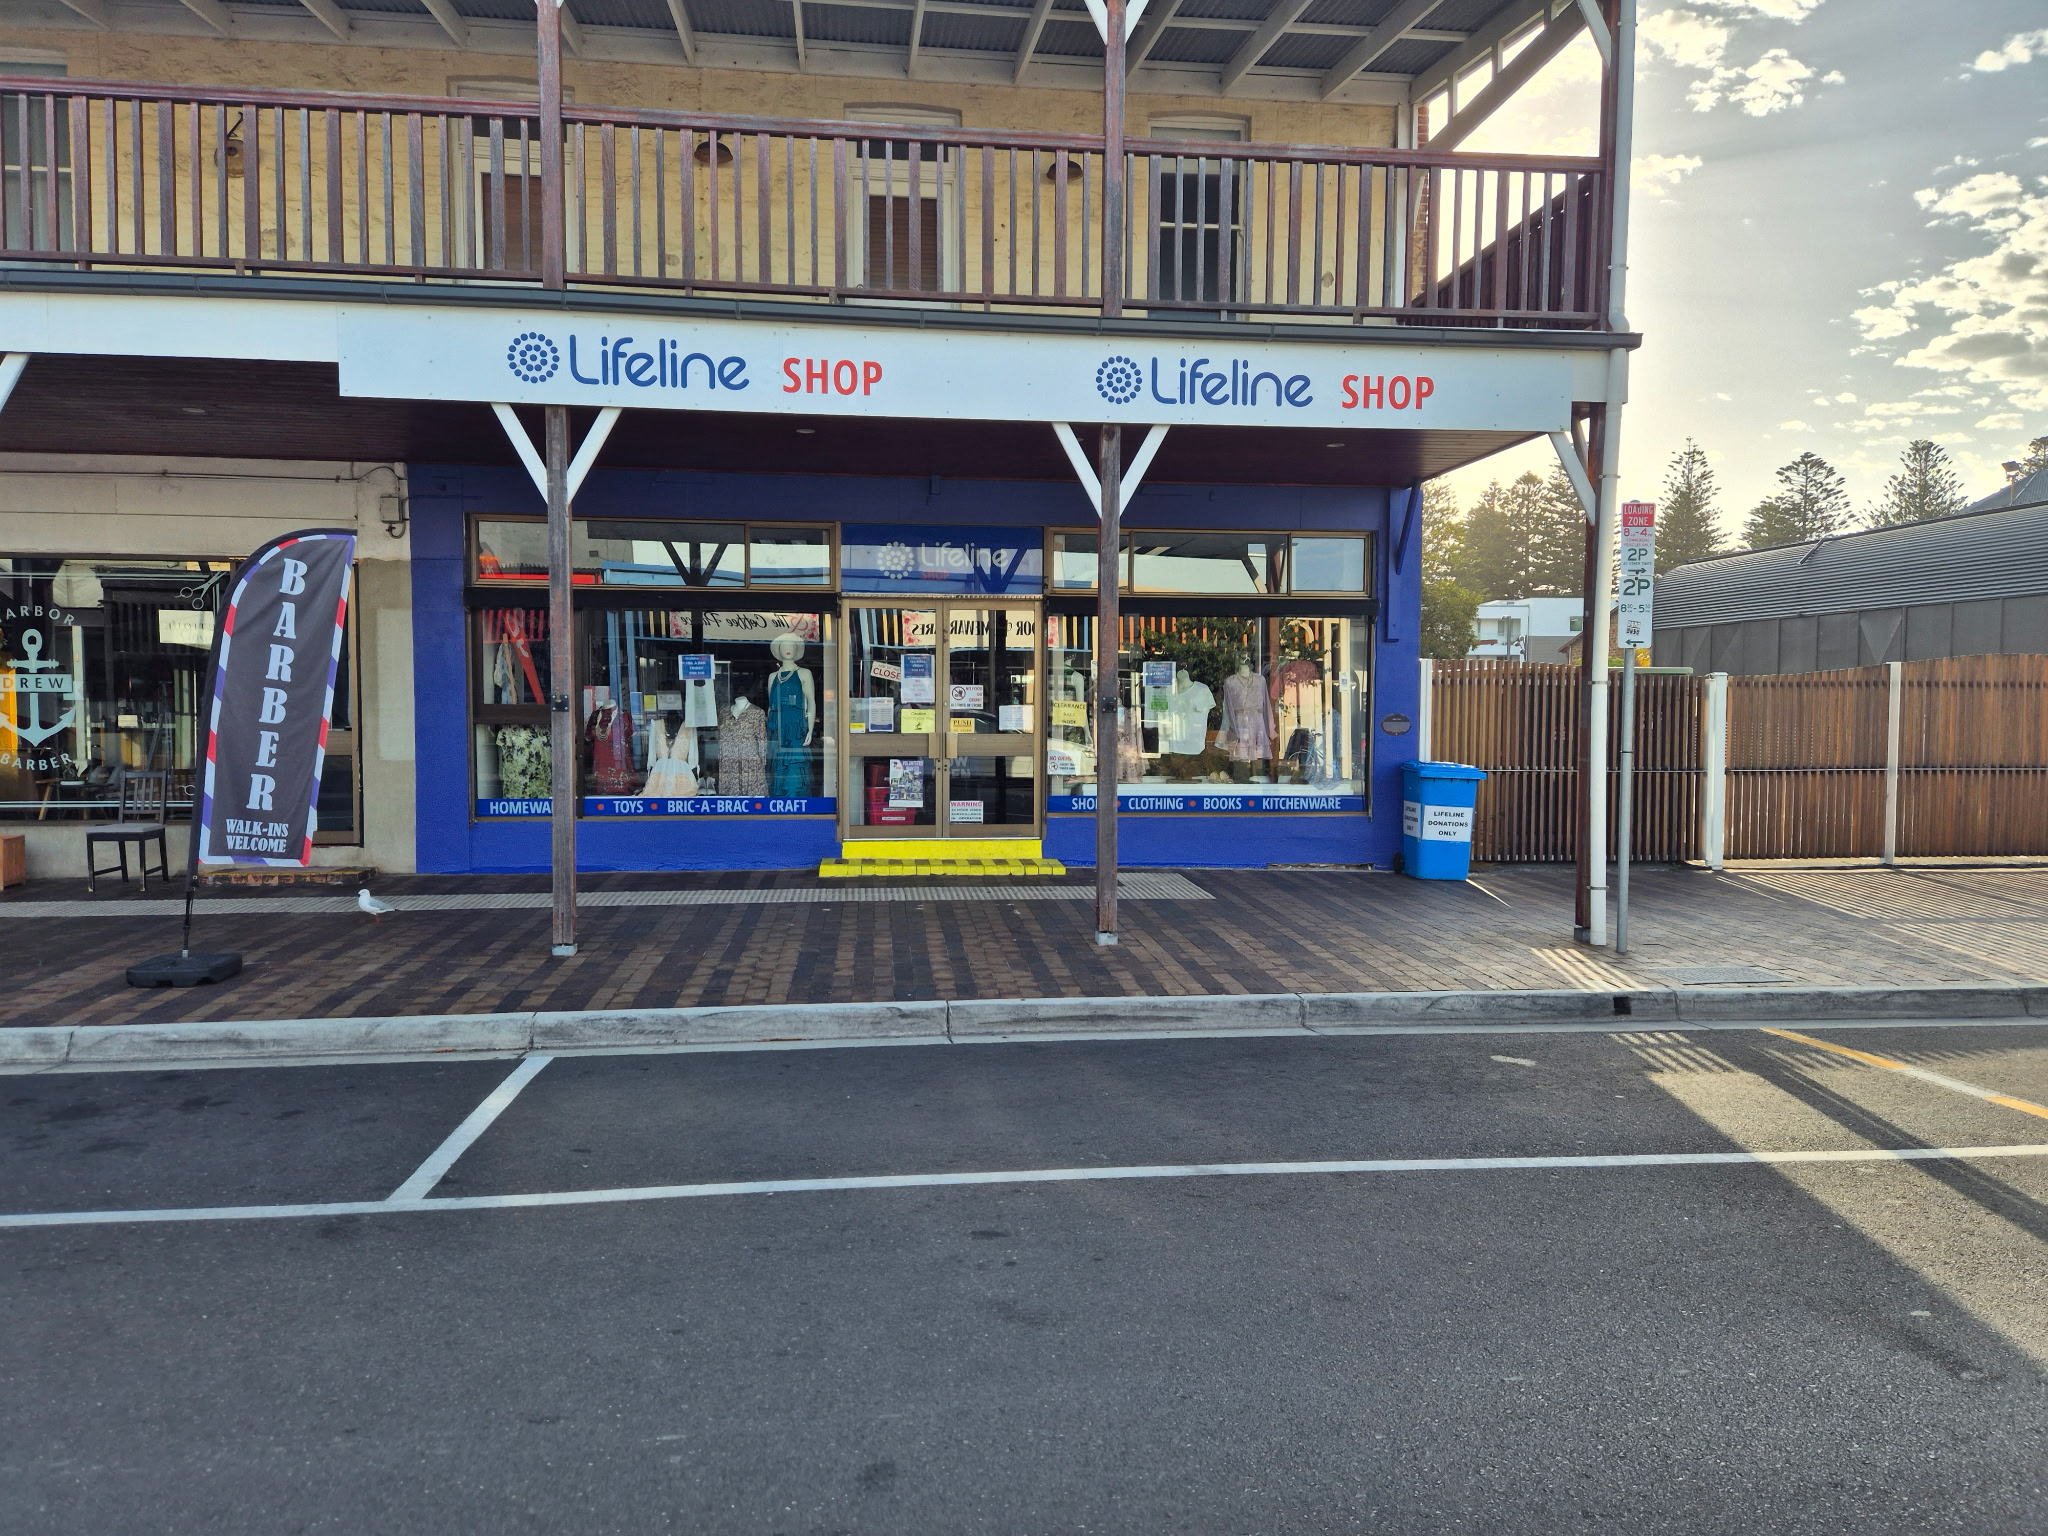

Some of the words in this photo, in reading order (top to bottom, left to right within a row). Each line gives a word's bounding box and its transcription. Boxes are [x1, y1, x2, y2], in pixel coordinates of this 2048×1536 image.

[570, 334, 750, 391] Lifeline
[782, 357, 883, 396] SHOP
[1151, 356, 1314, 408] Lifeline
[1341, 374, 1435, 410] SHOP
[1624, 505, 1653, 515] LOADING
[1627, 516, 1649, 526] ZONE
[921, 542, 1008, 568] Lifeline
[1627, 548, 1648, 562] 2P
[1623, 578, 1651, 596] 2P
[0, 605, 75, 626] ARBOR
[873, 667, 901, 680] CLOSE
[2, 677, 64, 689] DREW
[247, 557, 308, 811] BARBER
[0, 752, 72, 771] BARBER
[613, 799, 644, 813] TOYS
[667, 799, 749, 813] BRIC-A-BRAC
[769, 799, 807, 813] CRAFT
[1128, 797, 1184, 810] CLOTHING
[1203, 797, 1242, 810] BOOKS
[1262, 797, 1342, 810] KITCHENWARE
[225, 818, 289, 837] WALK-INS
[1428, 820, 1469, 828] DONATIONS
[226, 834, 287, 853] WELCOME
